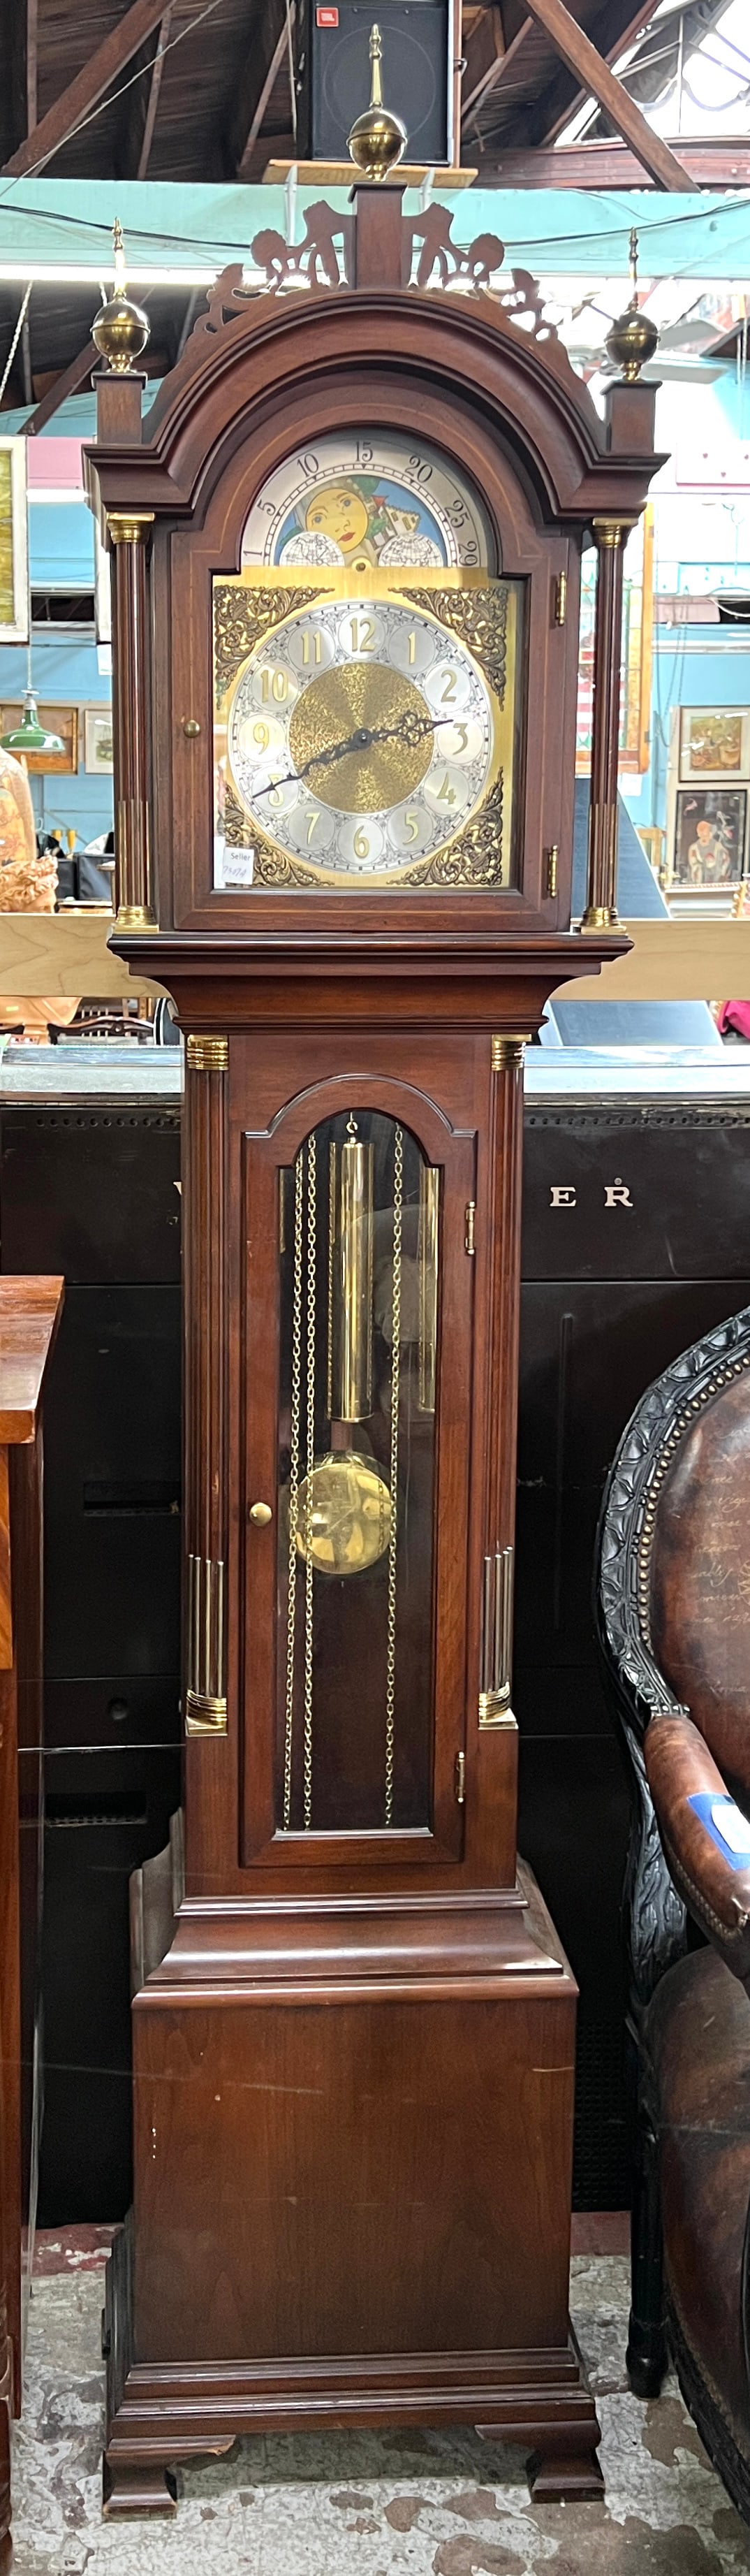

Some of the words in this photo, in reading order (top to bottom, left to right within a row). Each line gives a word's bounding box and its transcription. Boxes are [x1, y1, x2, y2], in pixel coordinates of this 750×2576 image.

[297, 453, 320, 478] 10
[355, 441, 374, 462] 15
[405, 455, 433, 482] 20
[257, 499, 277, 516] 5
[445, 499, 469, 528] 25
[457, 541, 478, 566] 29
[301, 631, 322, 664] 11
[349, 618, 376, 653] 12
[407, 631, 417, 664] 1
[260, 669, 288, 703] 10
[440, 669, 457, 704] 2
[253, 722, 270, 755] 9
[452, 722, 469, 755] 3
[267, 773, 284, 806] 8
[436, 771, 457, 805] 4
[304, 813, 321, 845] 7
[353, 825, 369, 859] 6
[402, 812, 420, 845] 5
[230, 852, 251, 861] Seller
